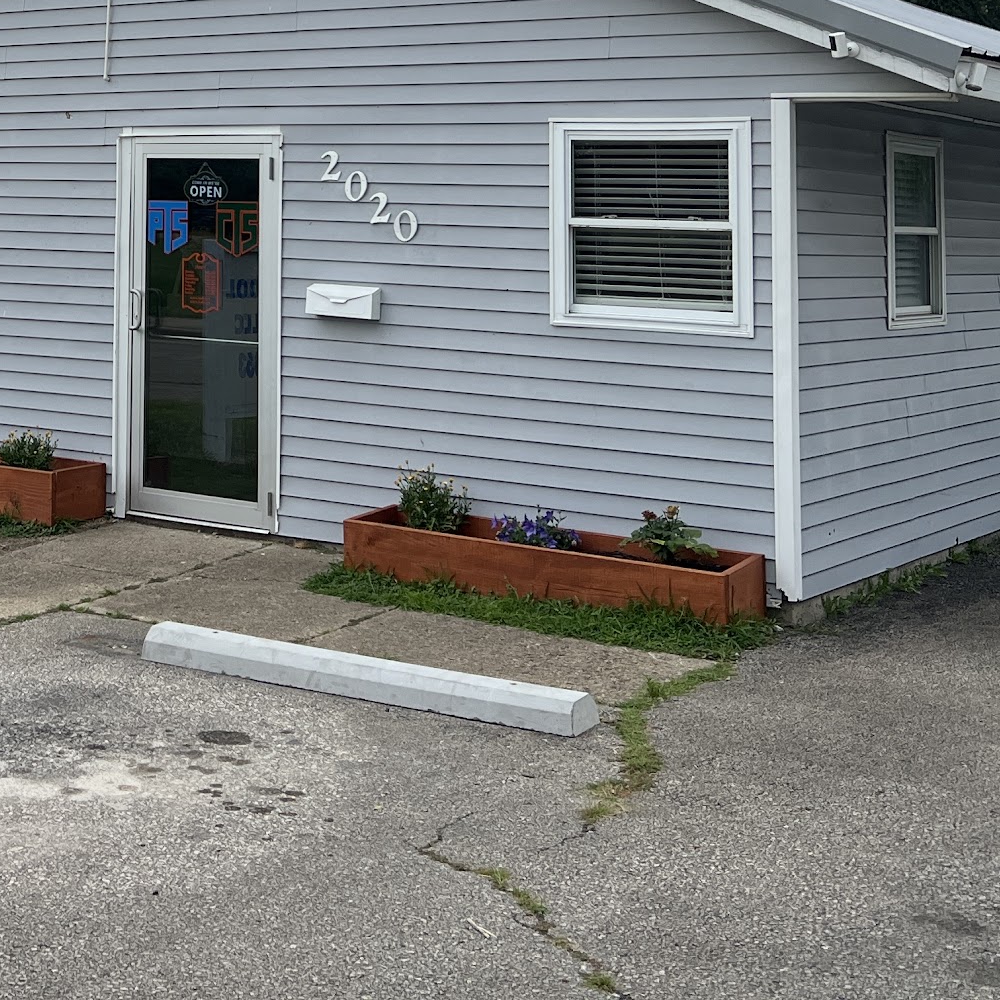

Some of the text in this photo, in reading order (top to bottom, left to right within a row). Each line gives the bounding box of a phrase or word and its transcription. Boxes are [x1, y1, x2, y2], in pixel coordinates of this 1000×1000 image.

[190, 185, 222, 198] OPEN
[320, 150, 418, 242] 2020
[148, 200, 188, 254] PTS
